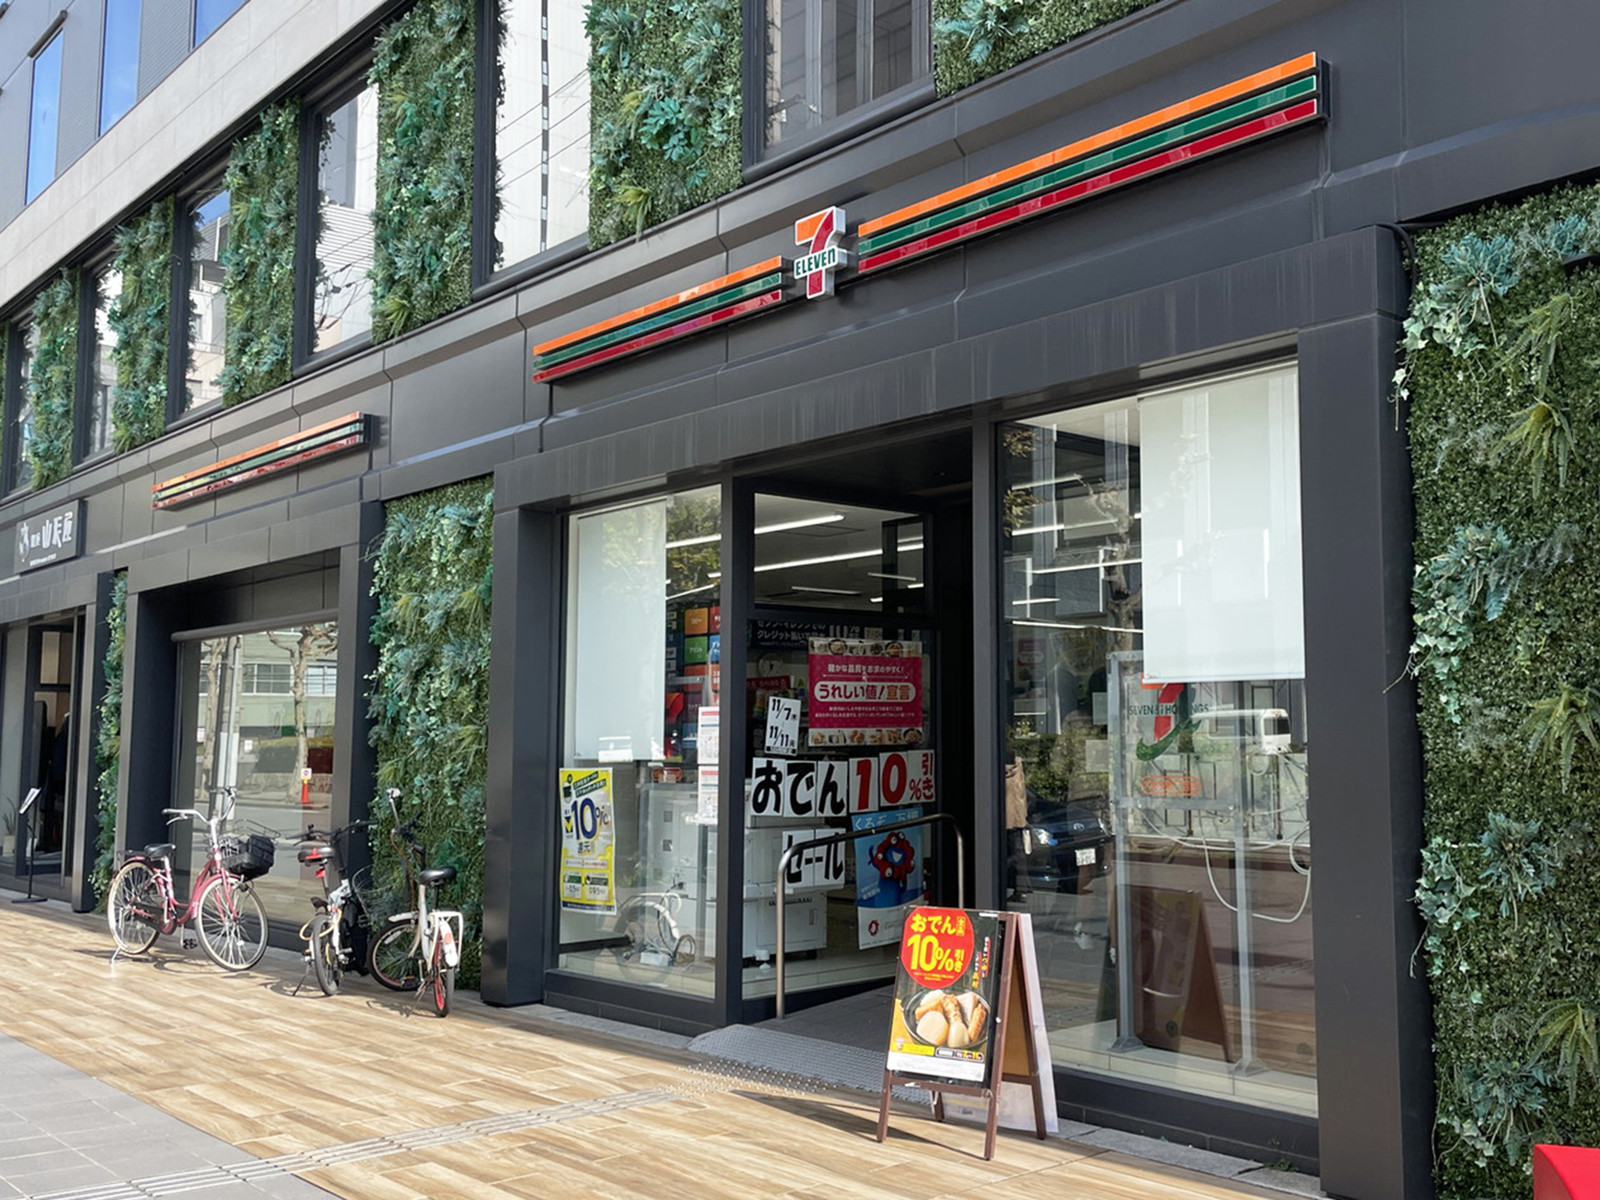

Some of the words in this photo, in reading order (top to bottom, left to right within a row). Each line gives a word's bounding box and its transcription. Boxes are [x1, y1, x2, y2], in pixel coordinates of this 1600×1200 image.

[818, 684, 910, 700] うれしい値!宣言
[752, 760, 846, 815] おでん
[784, 831, 845, 884] セール
[910, 913, 957, 935] おでん
[907, 934, 965, 973] 10%引き
